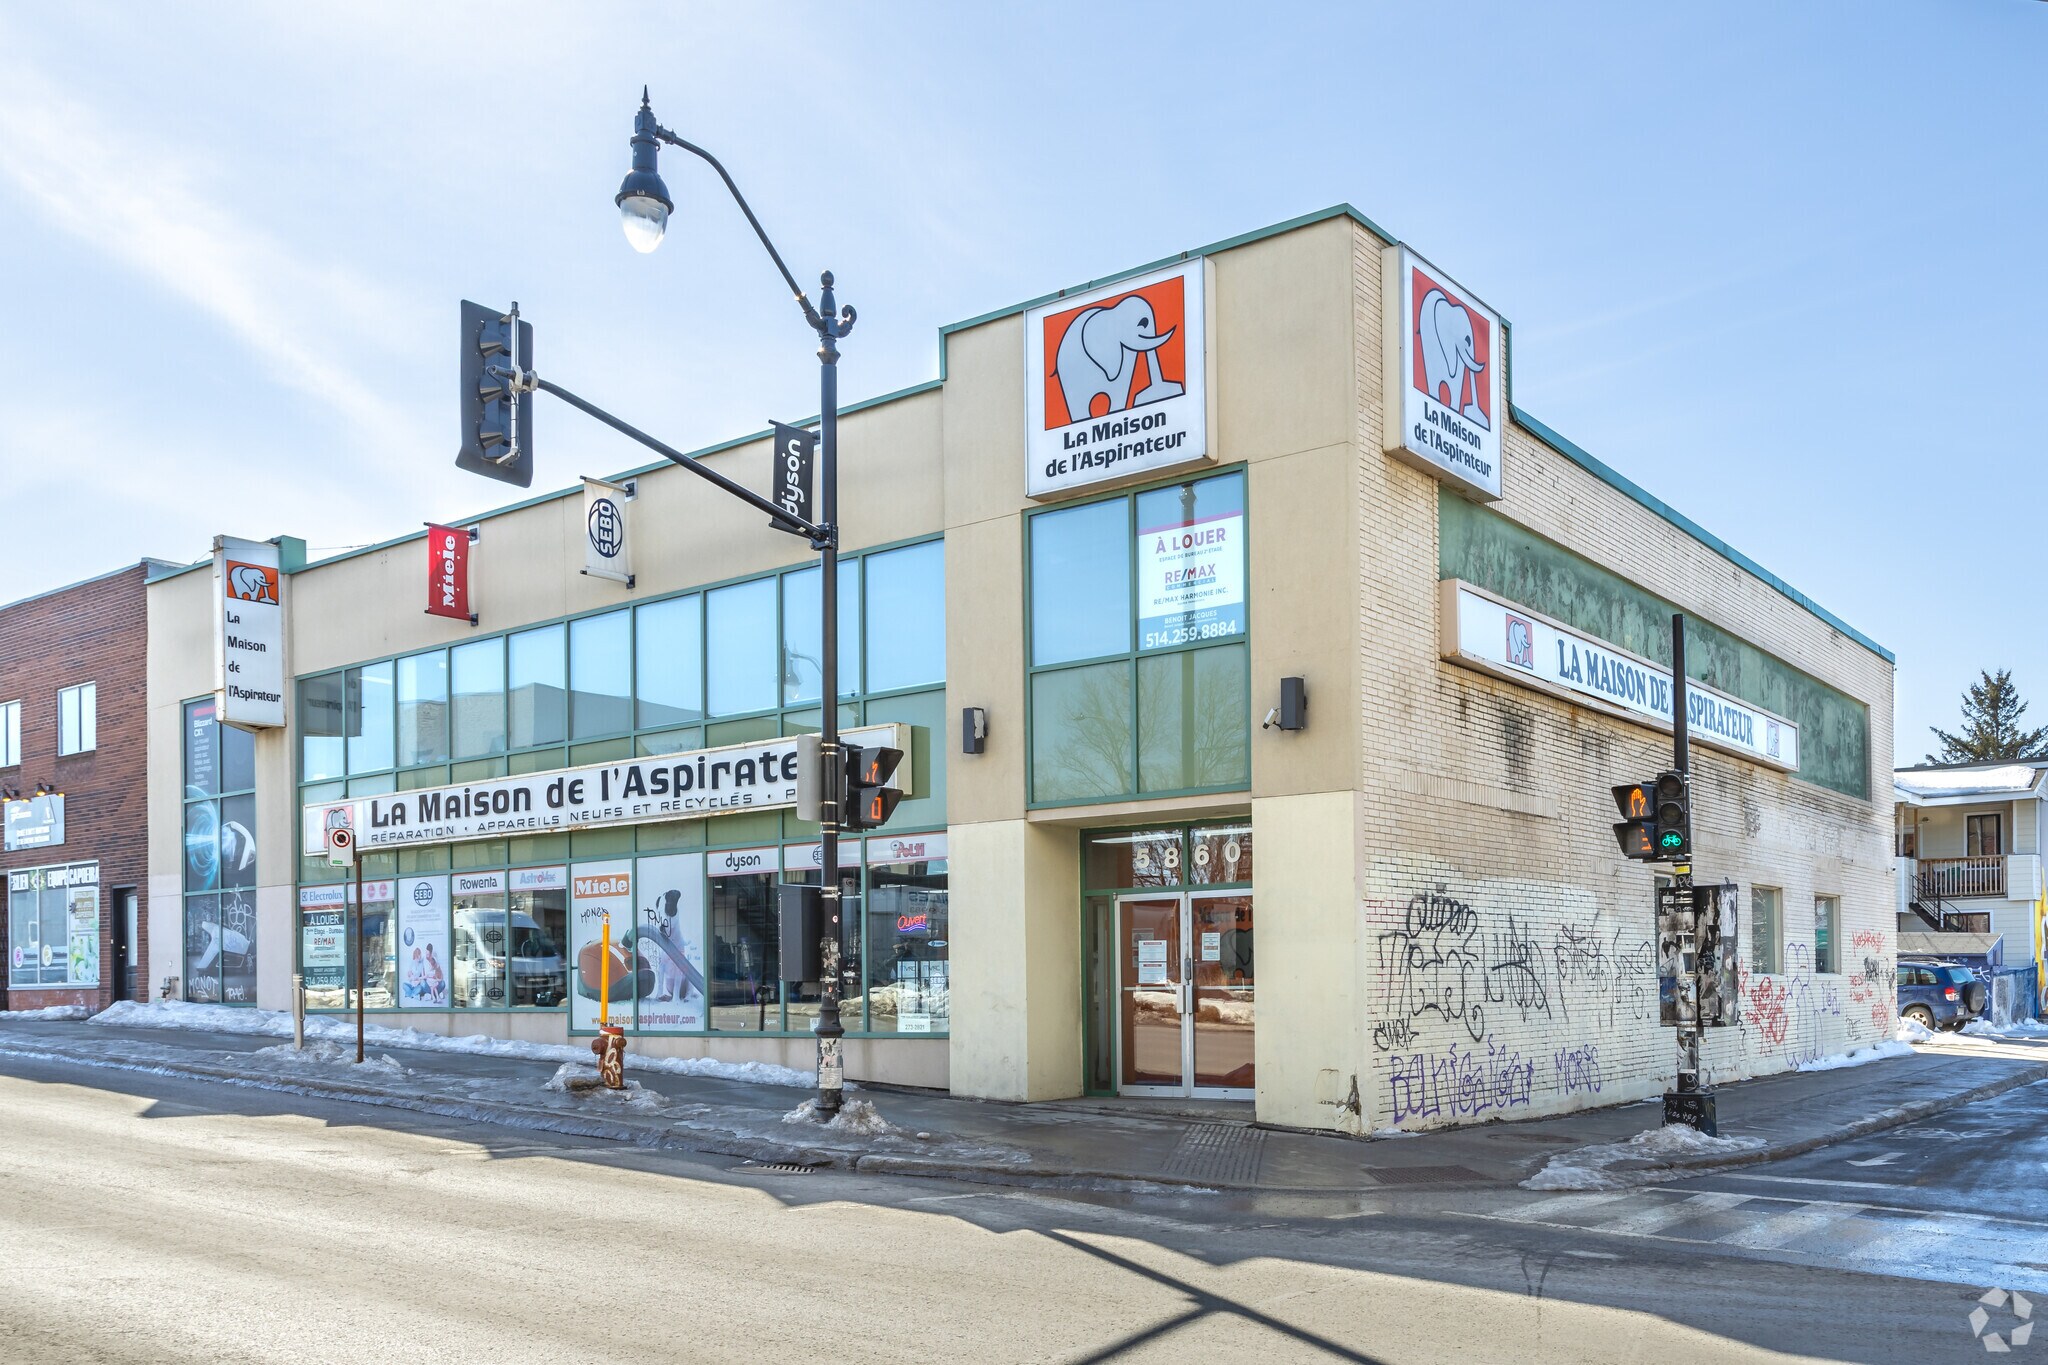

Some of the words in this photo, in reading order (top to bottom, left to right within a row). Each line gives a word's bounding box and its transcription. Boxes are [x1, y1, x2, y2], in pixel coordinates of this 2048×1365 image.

[1063, 431, 1087, 450] La
[1092, 412, 1166, 443] Maison
[1424, 401, 1438, 426] La
[1441, 410, 1481, 450] Maison
[1046, 458, 1067, 478] de
[1072, 431, 1186, 471] l'Aspirateur
[1414, 423, 1428, 444] de
[1430, 429, 1491, 478] l'Aspirateur
[781, 438, 805, 517] dyson
[599, 502, 613, 555] SEBO
[1156, 536, 1166, 554] À
[1173, 527, 1226, 551] LOUER
[442, 535, 456, 608] Miele
[1165, 563, 1216, 583] RE/MAX
[1154, 593, 1179, 605] RE/MAX
[1181, 590, 1213, 602] HARMONIE
[227, 611, 240, 624] La
[1165, 614, 1187, 624] BENOIT
[1189, 610, 1217, 620] JACQUES
[1145, 620, 1236, 647] 514.259.8884
[228, 635, 266, 652] Maison
[228, 660, 240, 673] de
[229, 685, 281, 703] l'Aspirateur
[1558, 639, 1583, 684] LA
[1585, 649, 1646, 707] MAISON
[1649, 675, 1668, 714] DE
[1671, 683, 1754, 746] SPIRATEUR
[371, 800, 406, 828] La
[419, 787, 531, 823] Maison
[547, 777, 584, 809] de
[601, 752, 797, 801] l'Aspirate
[371, 826, 454, 842] RÉPARATION
[478, 815, 559, 832] APPAREILS
[570, 807, 622, 821] NEUFS
[633, 803, 651, 814] ET
[661, 792, 752, 811] RECYCLÉS
[725, 852, 761, 871] dyson
[1136, 842, 1241, 868] 5860
[460, 876, 497, 890] Rowenta
[575, 878, 628, 896] Miele
[309, 889, 342, 902] Electrolux
[414, 889, 432, 899] SEBO
[316, 914, 340, 926] LOUER
[897, 913, 927, 929] Ouvert
[314, 937, 335, 945] RE/MAX
[930, 976, 946, 985] SEBO
